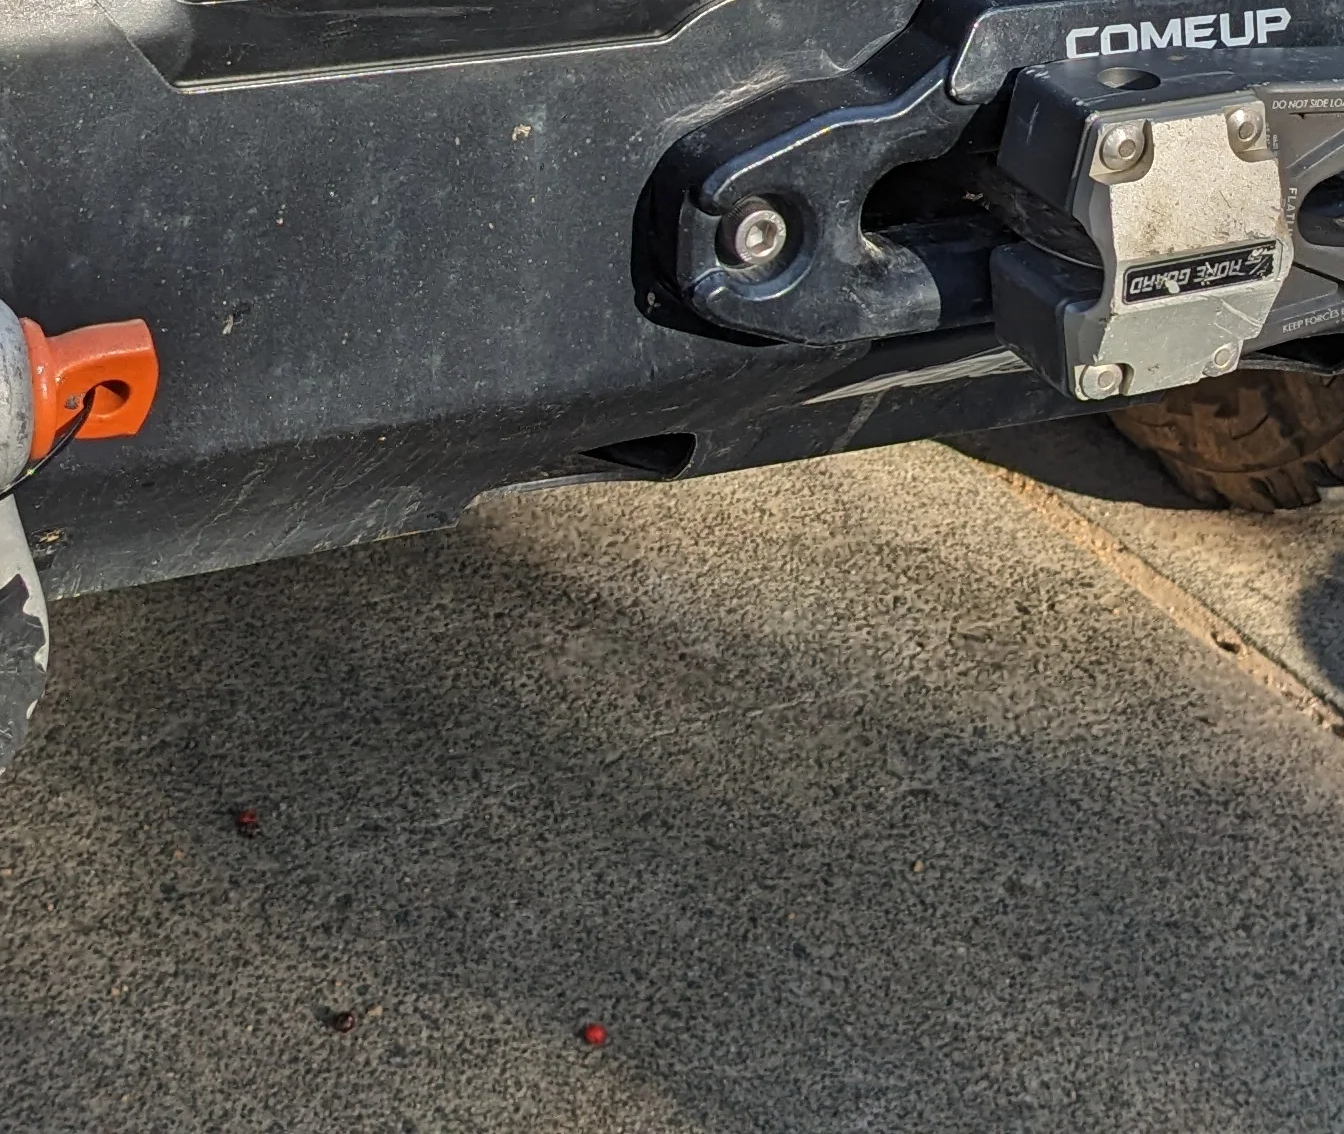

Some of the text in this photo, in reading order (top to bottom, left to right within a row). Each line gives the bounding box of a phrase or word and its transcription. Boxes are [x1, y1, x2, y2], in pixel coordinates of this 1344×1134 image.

[1065, 8, 1291, 59] COMEUP
[1272, 100, 1287, 110] DO
[1287, 99, 1308, 109] NOT
[1309, 98, 1329, 108] SIDE
[1282, 319, 1303, 333] KEEP
[1305, 308, 1340, 325] FORCES
